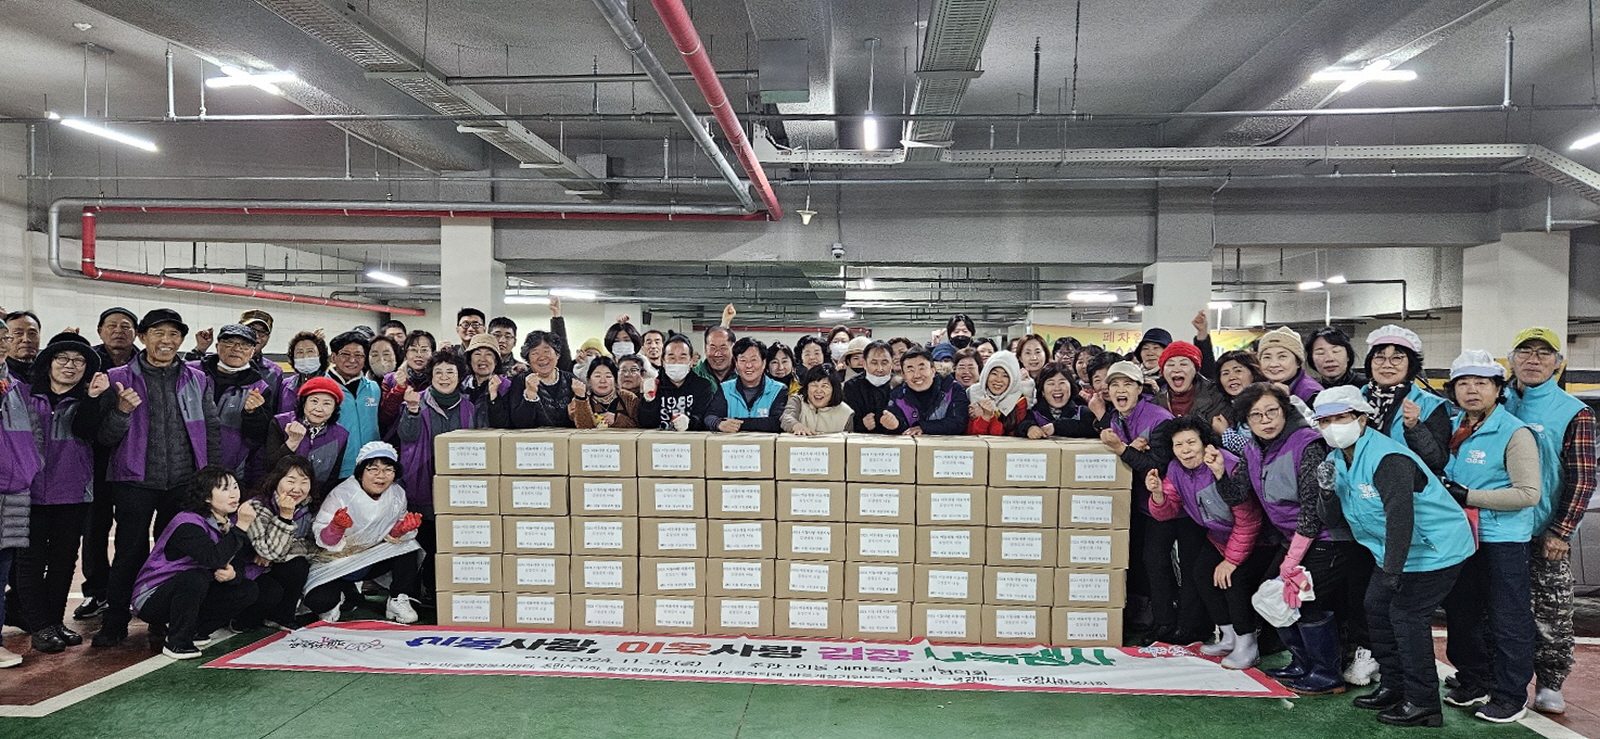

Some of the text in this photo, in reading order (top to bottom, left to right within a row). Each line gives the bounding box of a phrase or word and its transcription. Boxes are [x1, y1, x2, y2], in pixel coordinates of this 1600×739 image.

[660, 394, 694, 410] 1989
[616, 641, 806, 659] 이웃사랑
[817, 646, 914, 663] 김장
